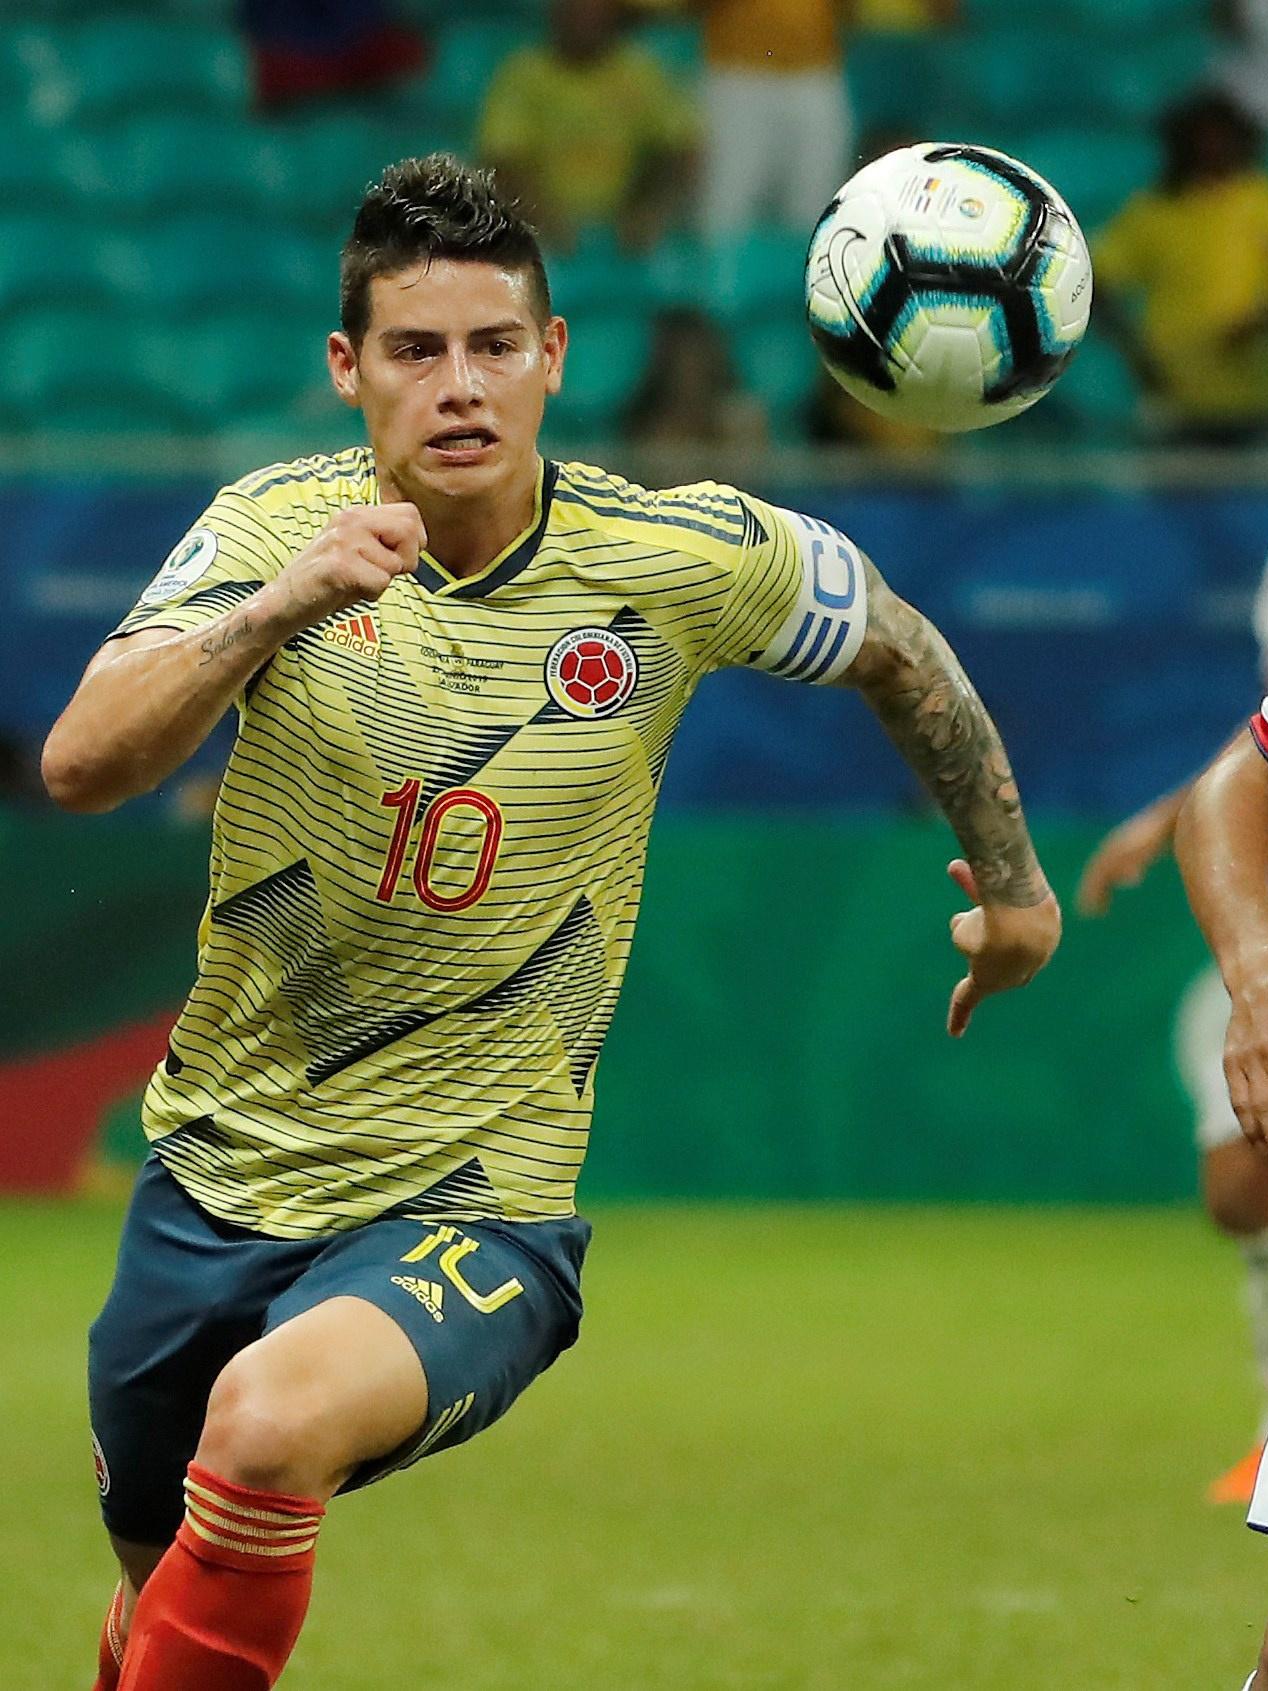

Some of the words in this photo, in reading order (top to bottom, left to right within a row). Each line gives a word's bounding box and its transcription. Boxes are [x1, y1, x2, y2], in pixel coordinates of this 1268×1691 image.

[812, 539, 856, 609] C
[324, 630, 383, 660] adidas
[376, 777, 504, 913] 10
[390, 1275, 444, 1324] adidas
